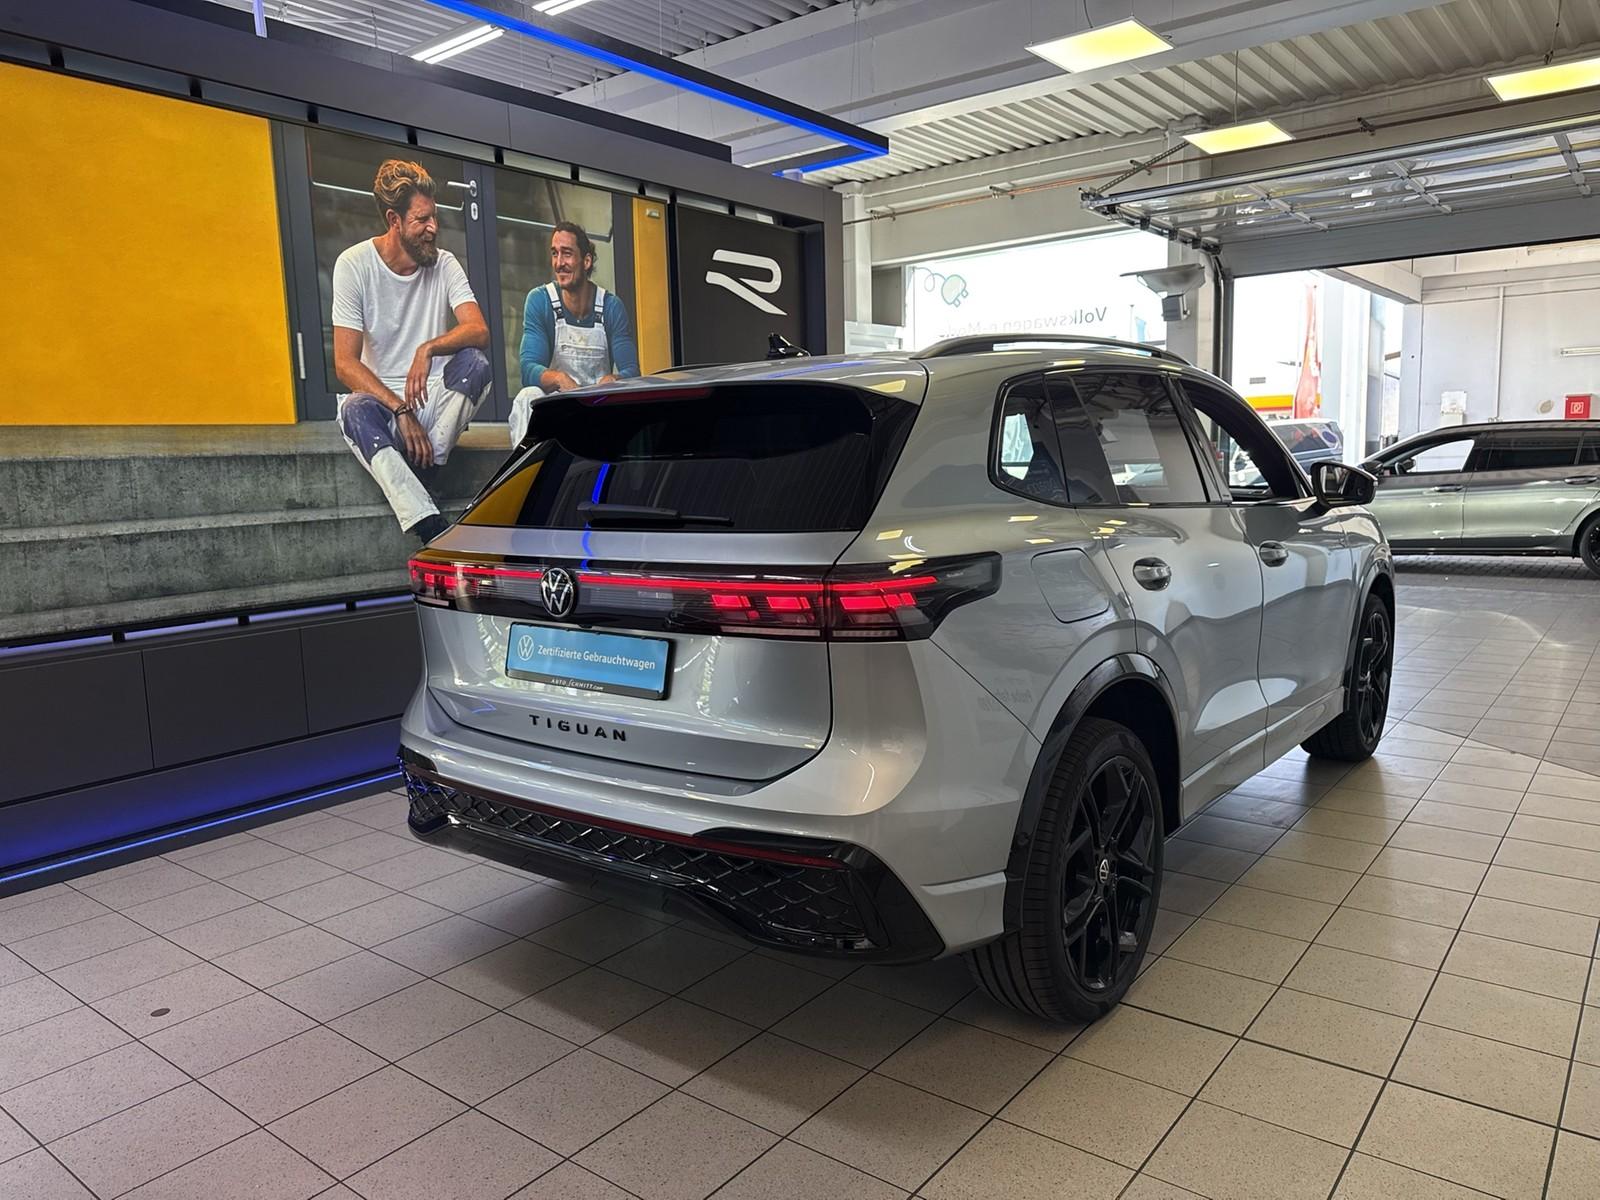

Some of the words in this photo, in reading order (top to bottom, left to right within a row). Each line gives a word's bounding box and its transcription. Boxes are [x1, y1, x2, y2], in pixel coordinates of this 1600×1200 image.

[537, 644, 582, 661] Zertifizierte
[583, 650, 656, 671] Gebrauchtwagen
[550, 678, 566, 686] AUTO
[529, 714, 627, 742] TIGUAN
